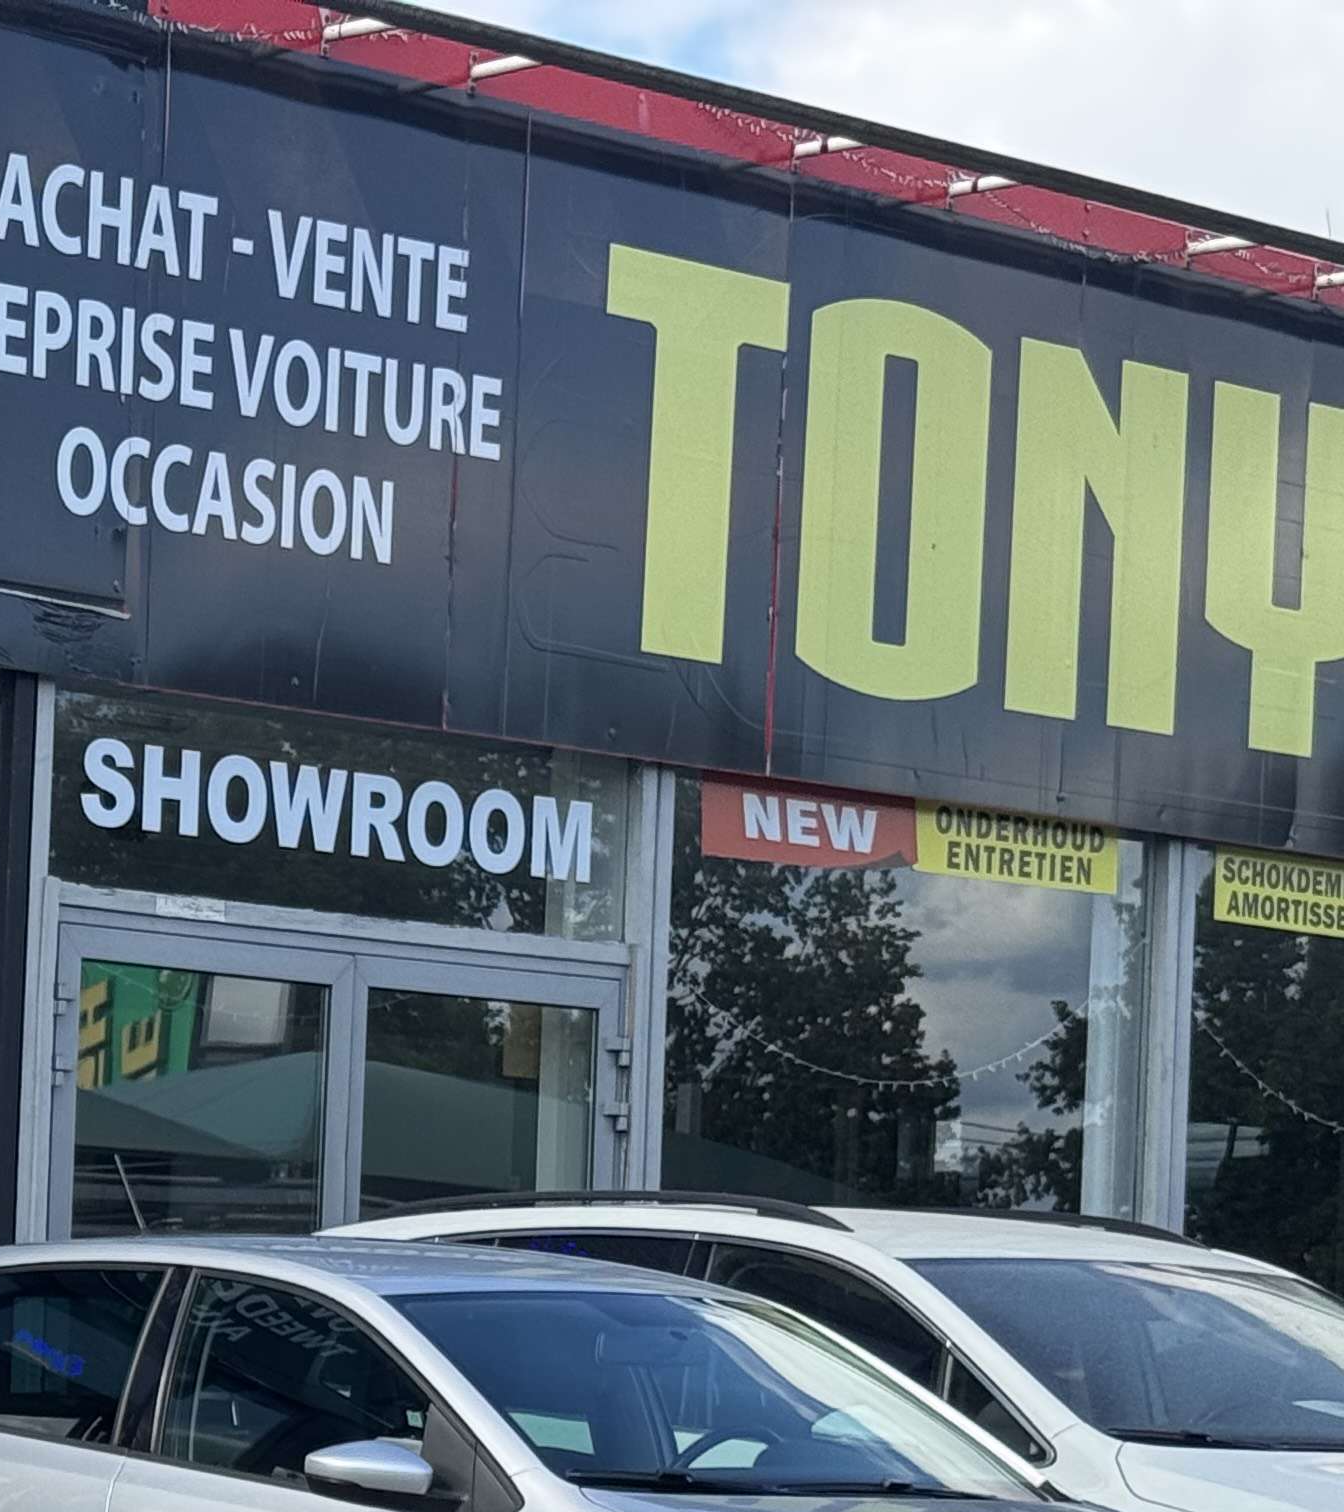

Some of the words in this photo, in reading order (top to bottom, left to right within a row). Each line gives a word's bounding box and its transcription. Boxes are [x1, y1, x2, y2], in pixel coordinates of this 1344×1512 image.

[268, 208, 470, 333] VENTE
[229, 326, 502, 462] VOITURE
[55, 426, 395, 567] OCCASION
[606, 242, 1344, 758] TONY
[80, 737, 593, 884] SHOWROOM
[743, 792, 878, 855] NEW
[935, 805, 1105, 853] ONDERHOUD
[946, 842, 1093, 887] ENTRETIEN
[1222, 857, 1344, 900] SCHOKDEM
